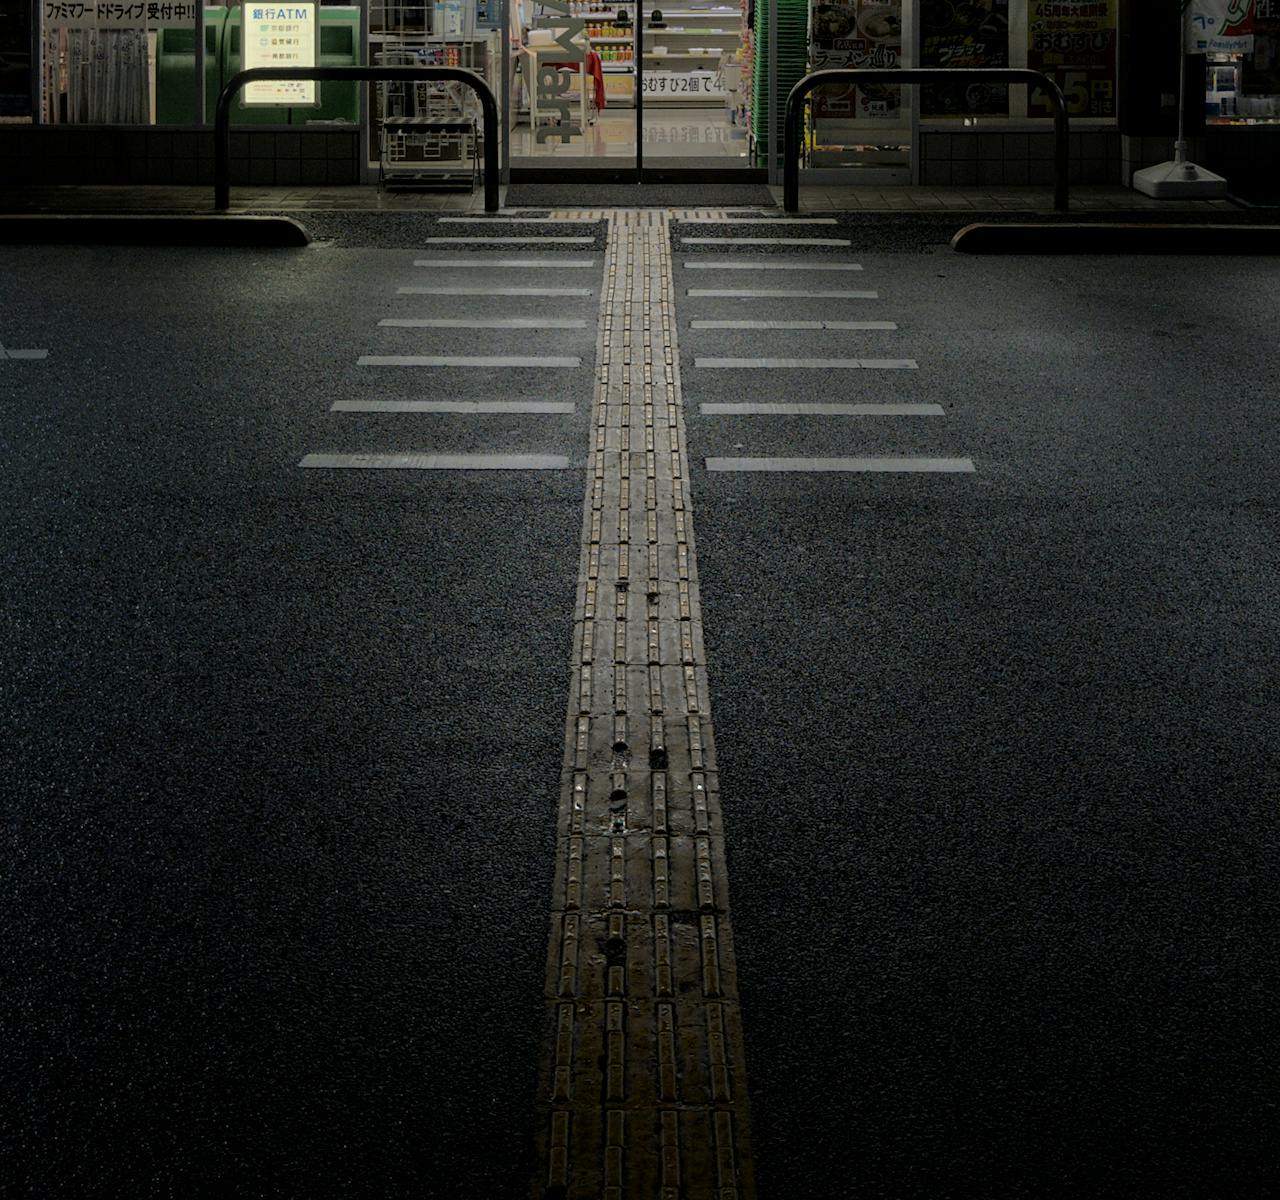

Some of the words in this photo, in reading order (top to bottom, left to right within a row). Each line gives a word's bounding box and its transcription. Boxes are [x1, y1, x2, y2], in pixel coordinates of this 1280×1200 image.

[253, 8, 307, 19] 銀行ATM
[815, 44, 896, 69] ラーメン巡り
